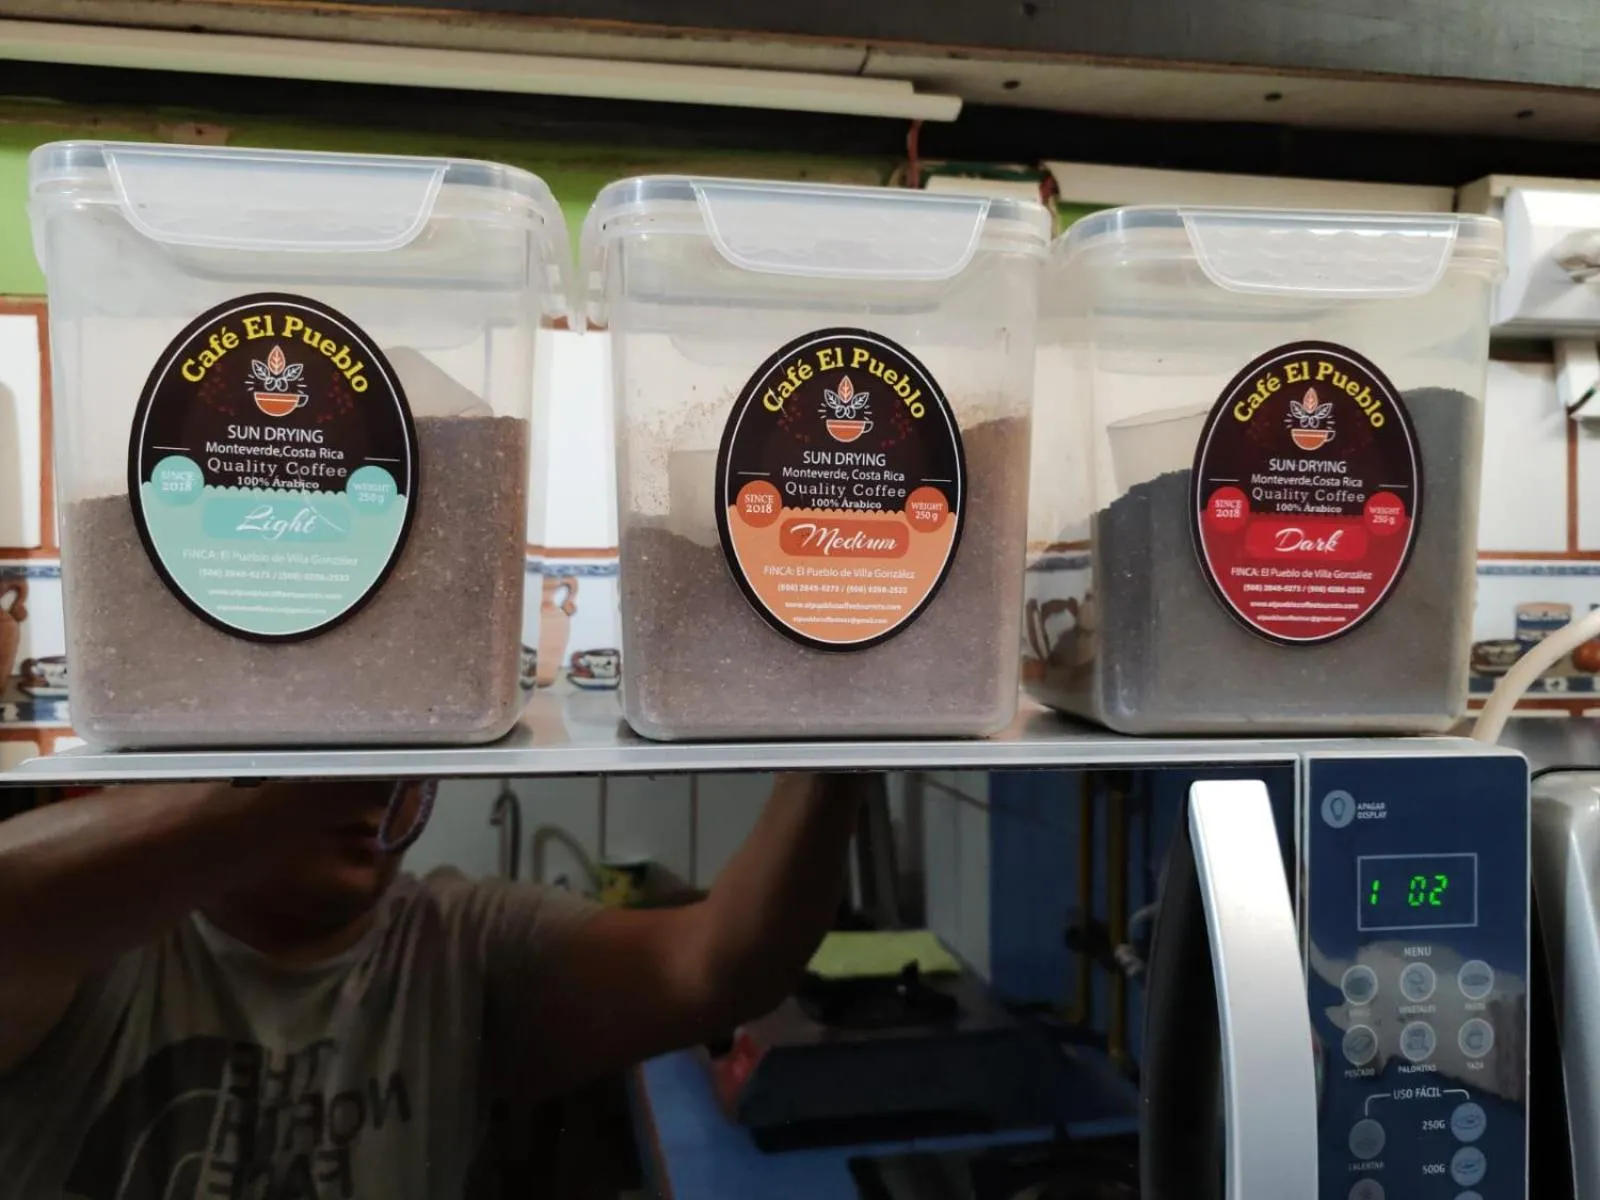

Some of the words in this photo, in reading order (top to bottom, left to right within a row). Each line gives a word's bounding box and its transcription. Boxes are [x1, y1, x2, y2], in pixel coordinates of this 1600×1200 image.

[181, 326, 240, 383] Café
[242, 314, 275, 340] El
[281, 315, 369, 393] Pueblo
[763, 359, 814, 412] Café
[816, 347, 844, 371] El
[850, 347, 926, 419] Pueblo
[1233, 372, 1282, 423] Café
[1283, 361, 1311, 384] El
[1315, 361, 1385, 428] Pueblo
[227, 424, 260, 440] SUN
[264, 426, 324, 444] DRYING
[319, 447, 344, 460] Rica
[803, 450, 832, 465] SUN
[835, 452, 887, 467] DRYING
[207, 457, 278, 476] Quality
[285, 461, 348, 478] Coffee
[1269, 458, 1297, 472] SUN
[1299, 460, 1347, 474] DRYING
[782, 467, 849, 481] Monteverde,
[852, 469, 881, 481] Costa
[884, 471, 905, 482] Rica
[162, 481, 193, 492] 2018
[237, 476, 270, 488] 100%
[1342, 477, 1363, 488] Rica
[785, 481, 846, 498] Quality
[853, 484, 906, 498] Coffee
[1251, 486, 1309, 502] Quality
[1314, 489, 1365, 503] Coffee
[744, 493, 774, 504] SINCE
[811, 498, 839, 508] 100%
[746, 503, 772, 514] 2018
[911, 502, 943, 512] WEIGHT
[1215, 500, 1242, 510] SINCE
[1276, 503, 1302, 512] 100%
[915, 511, 931, 520] 250
[931, 512, 939, 523] g
[1216, 508, 1240, 518] 2018
[1369, 507, 1400, 516] WEIGHT
[236, 504, 317, 540] Light
[1372, 514, 1387, 524] 250
[790, 523, 897, 556] Medium
[1274, 527, 1345, 553] Dark
[232, 552, 270, 563] Pueblo
[271, 553, 285, 563] de
[763, 565, 795, 576] FINCA:
[796, 566, 805, 576] El
[806, 566, 839, 577] Pueblo
[840, 567, 852, 577] de
[853, 567, 873, 578] Villa
[1231, 567, 1258, 577] FINCA:
[1261, 567, 1270, 577] El
[1270, 568, 1300, 578] Pueblo
[1301, 568, 1313, 578] de
[1314, 568, 1332, 579] Villa
[1357, 802, 1386, 811] APAGAR
[1357, 810, 1387, 819] DISPLAY
[1408, 874, 1449, 906] 02
[1404, 946, 1432, 957] MENU
[1344, 1068, 1375, 1078] PESCADO
[1397, 1063, 1437, 1074] PALOMITAS
[1393, 1089, 1413, 1100] USO
[1415, 1086, 1442, 1098] FÁCIL
[1422, 1119, 1446, 1130] 250G
[1422, 1164, 1446, 1175] 500G
